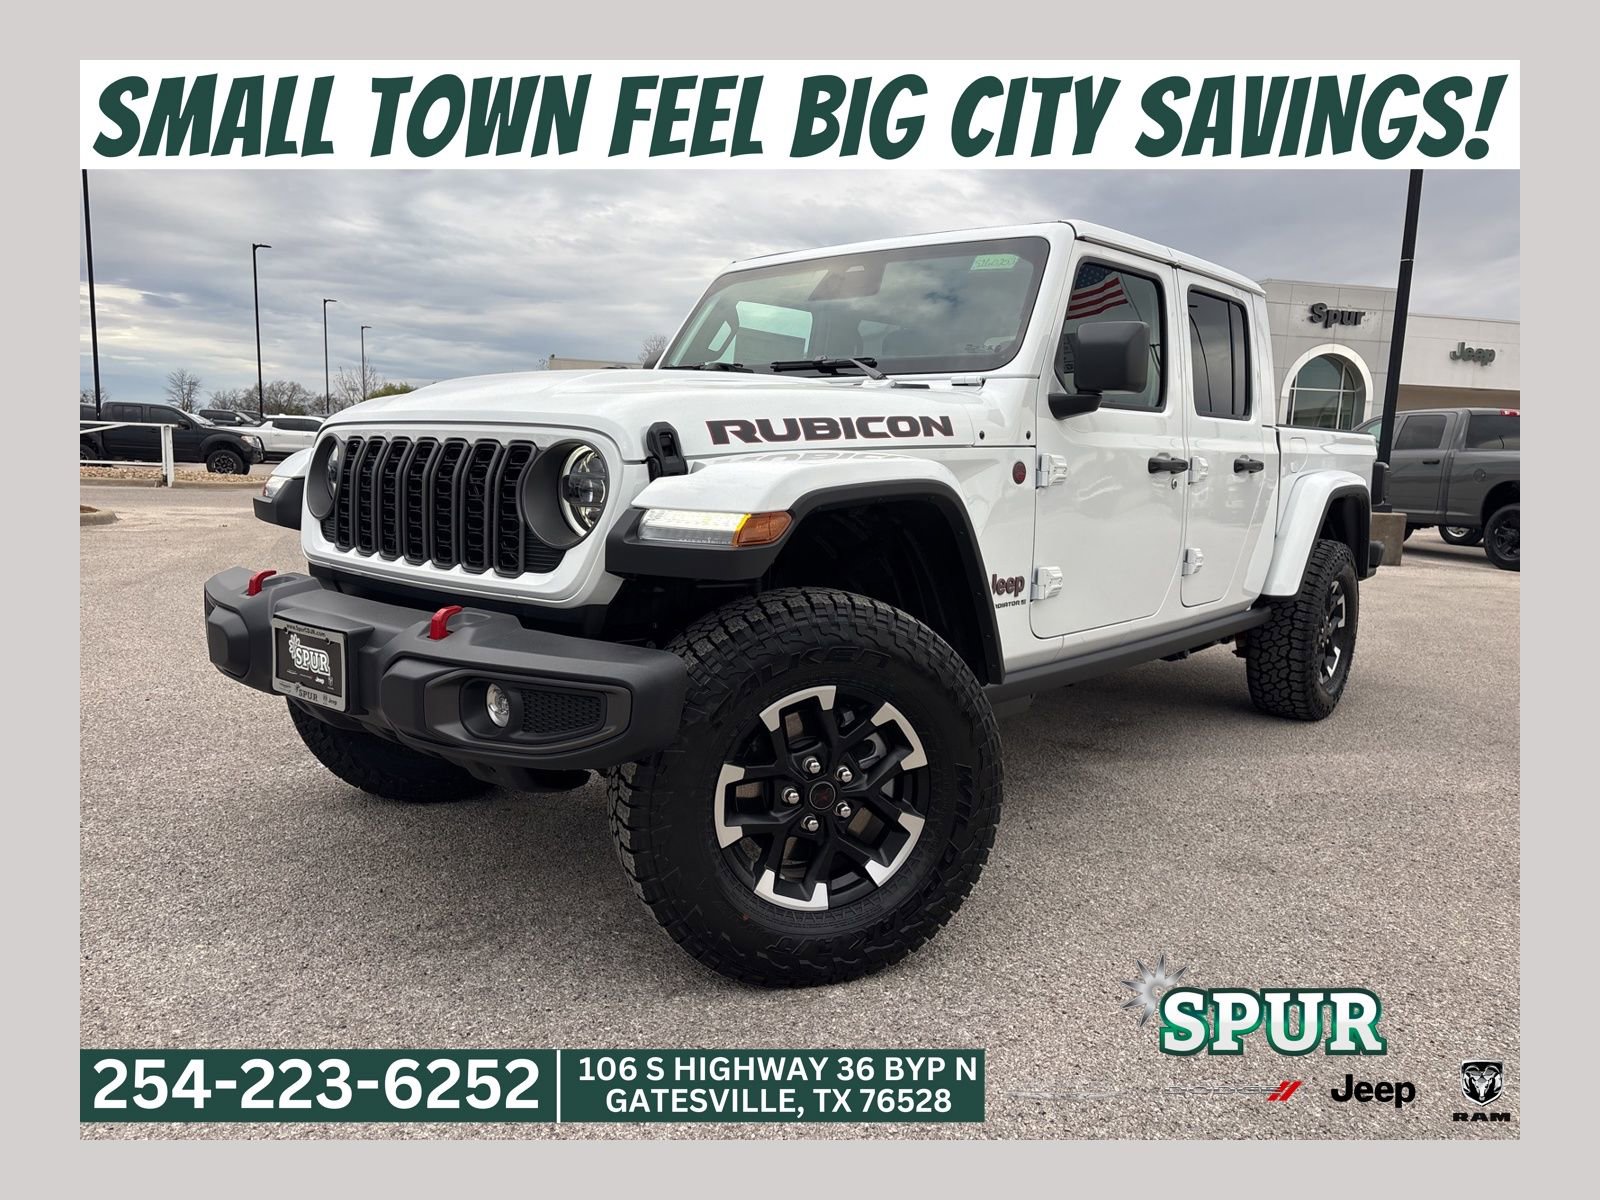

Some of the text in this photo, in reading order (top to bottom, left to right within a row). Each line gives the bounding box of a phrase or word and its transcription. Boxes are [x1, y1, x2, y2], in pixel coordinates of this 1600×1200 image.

[1308, 303, 1365, 329] Spur
[1450, 342, 1496, 367] Jeep
[705, 415, 954, 446] RUBICON
[295, 647, 329, 674] SPUR
[299, 689, 318, 701] SPUR
